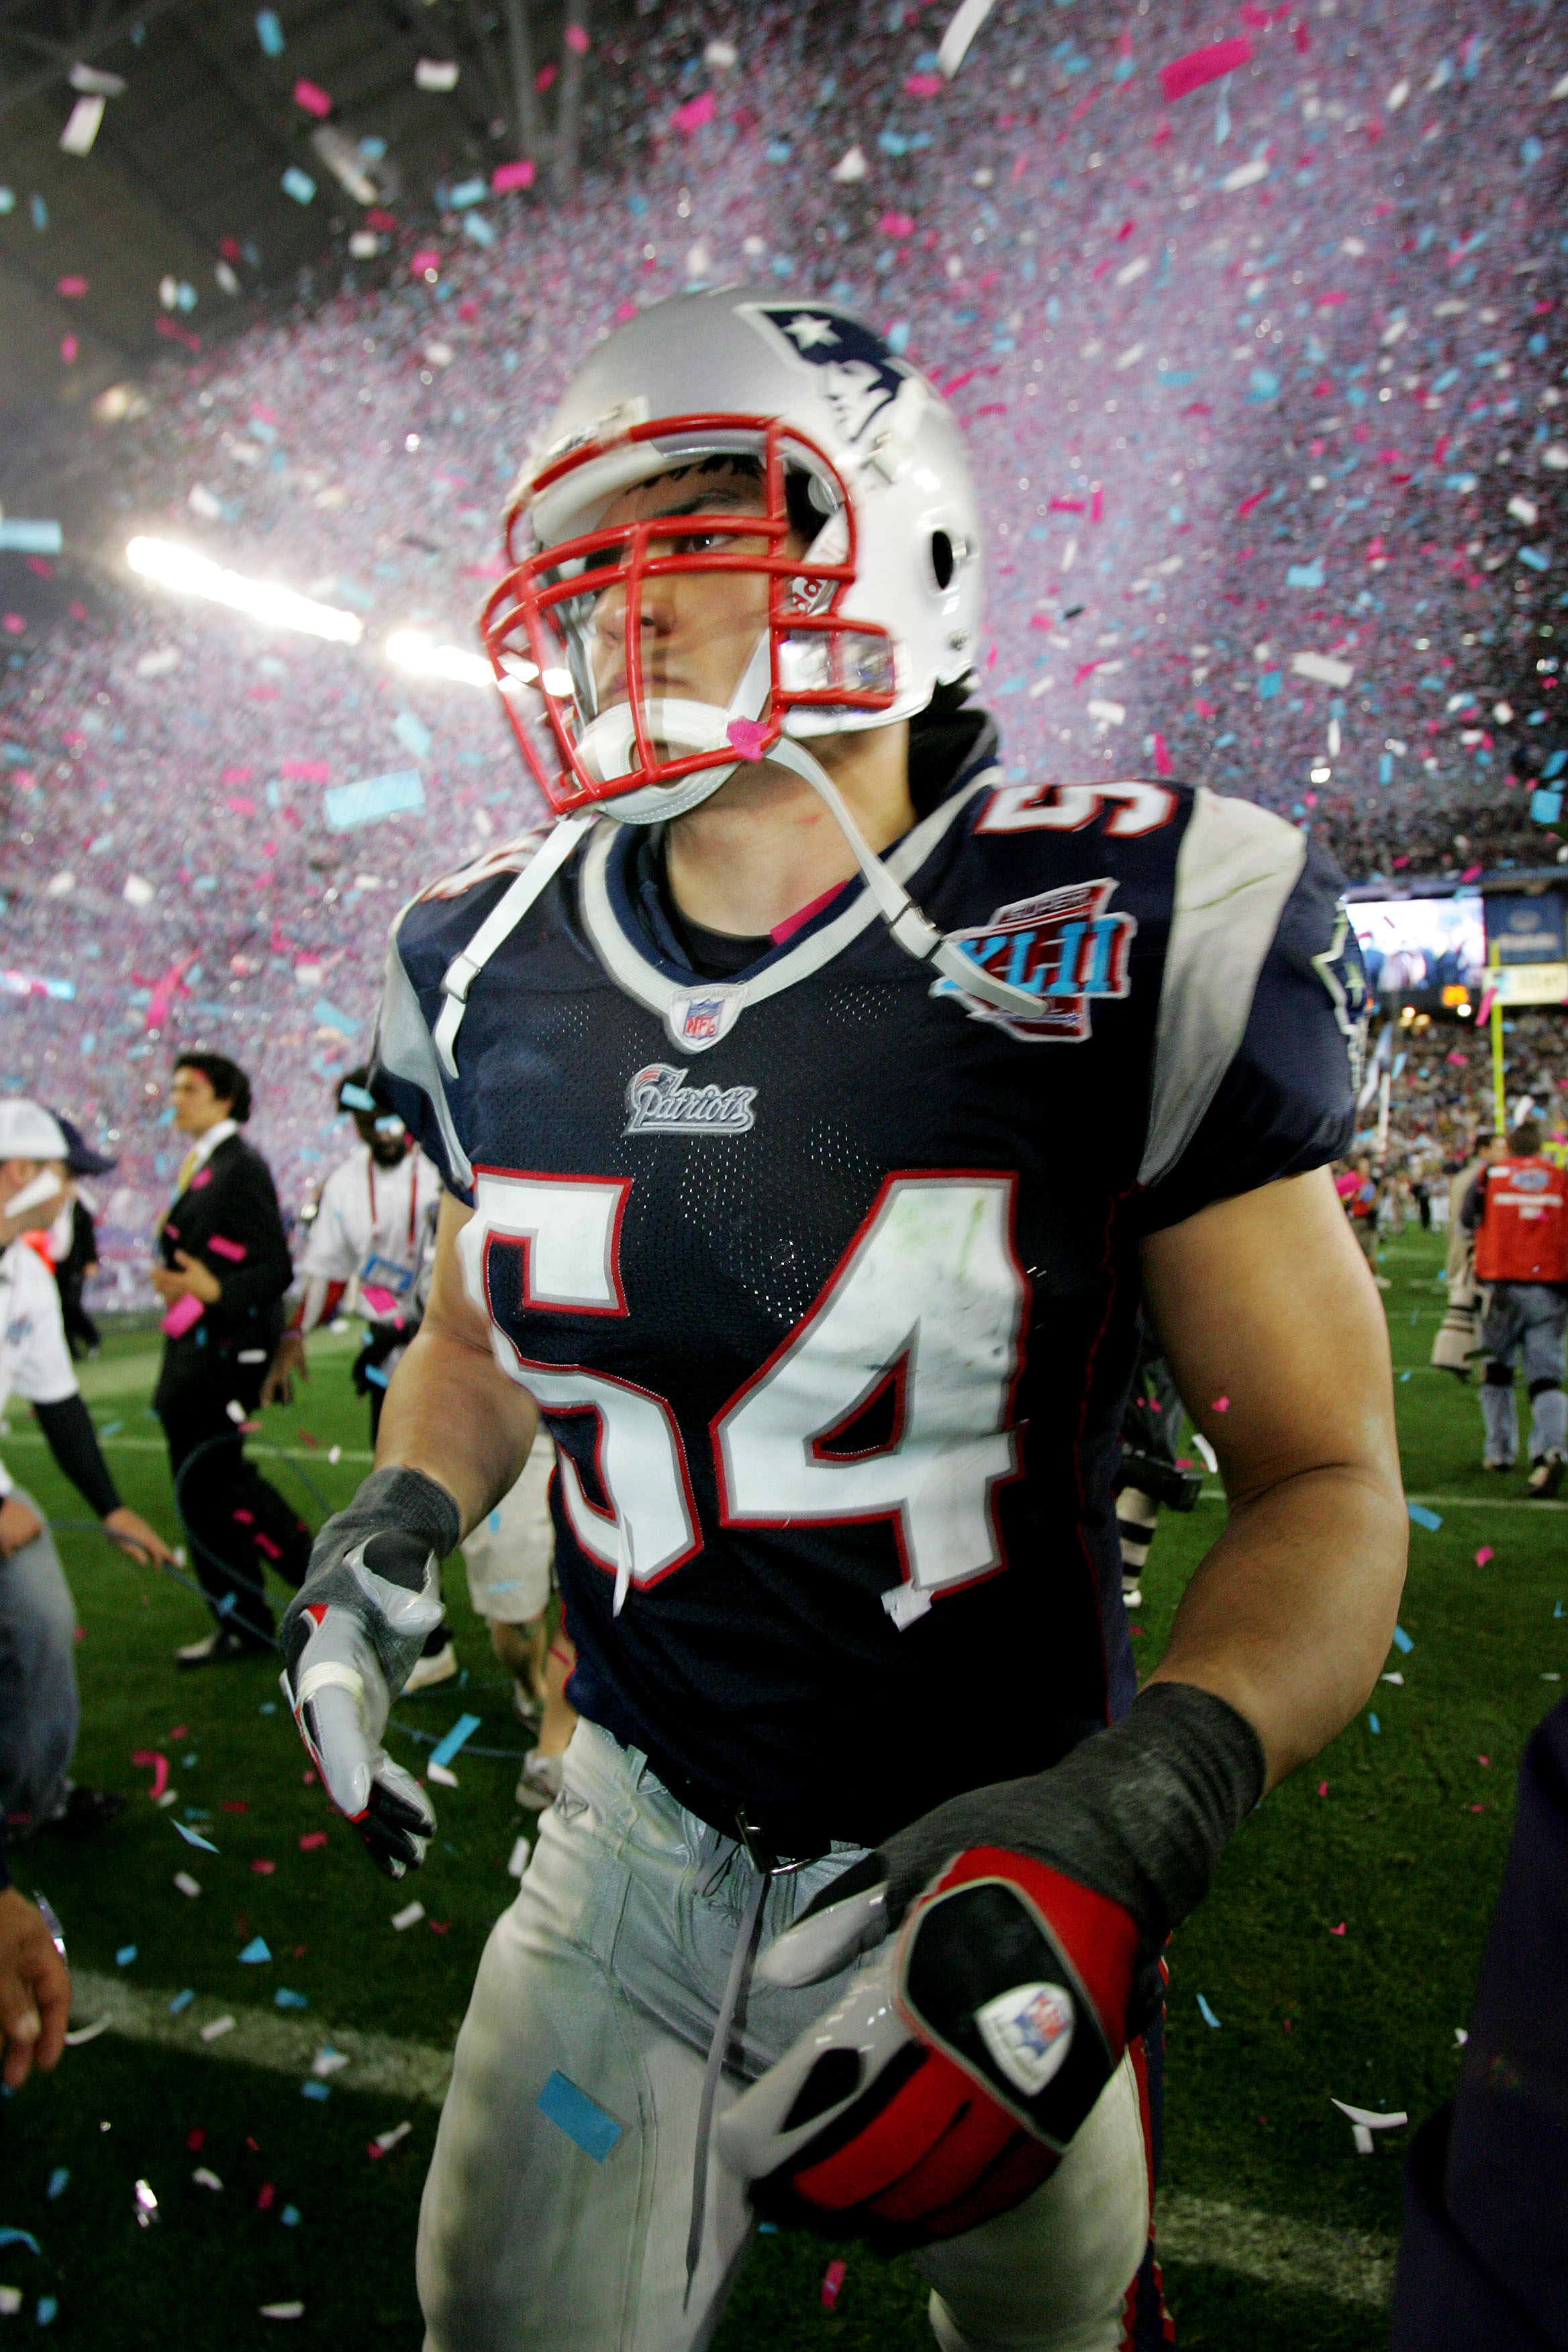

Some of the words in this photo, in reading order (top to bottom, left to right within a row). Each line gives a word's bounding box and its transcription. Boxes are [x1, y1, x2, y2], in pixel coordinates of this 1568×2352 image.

[686, 1016, 716, 1036] NFL
[631, 1083, 758, 1130] Patriots
[458, 1167, 1031, 1596] 54
